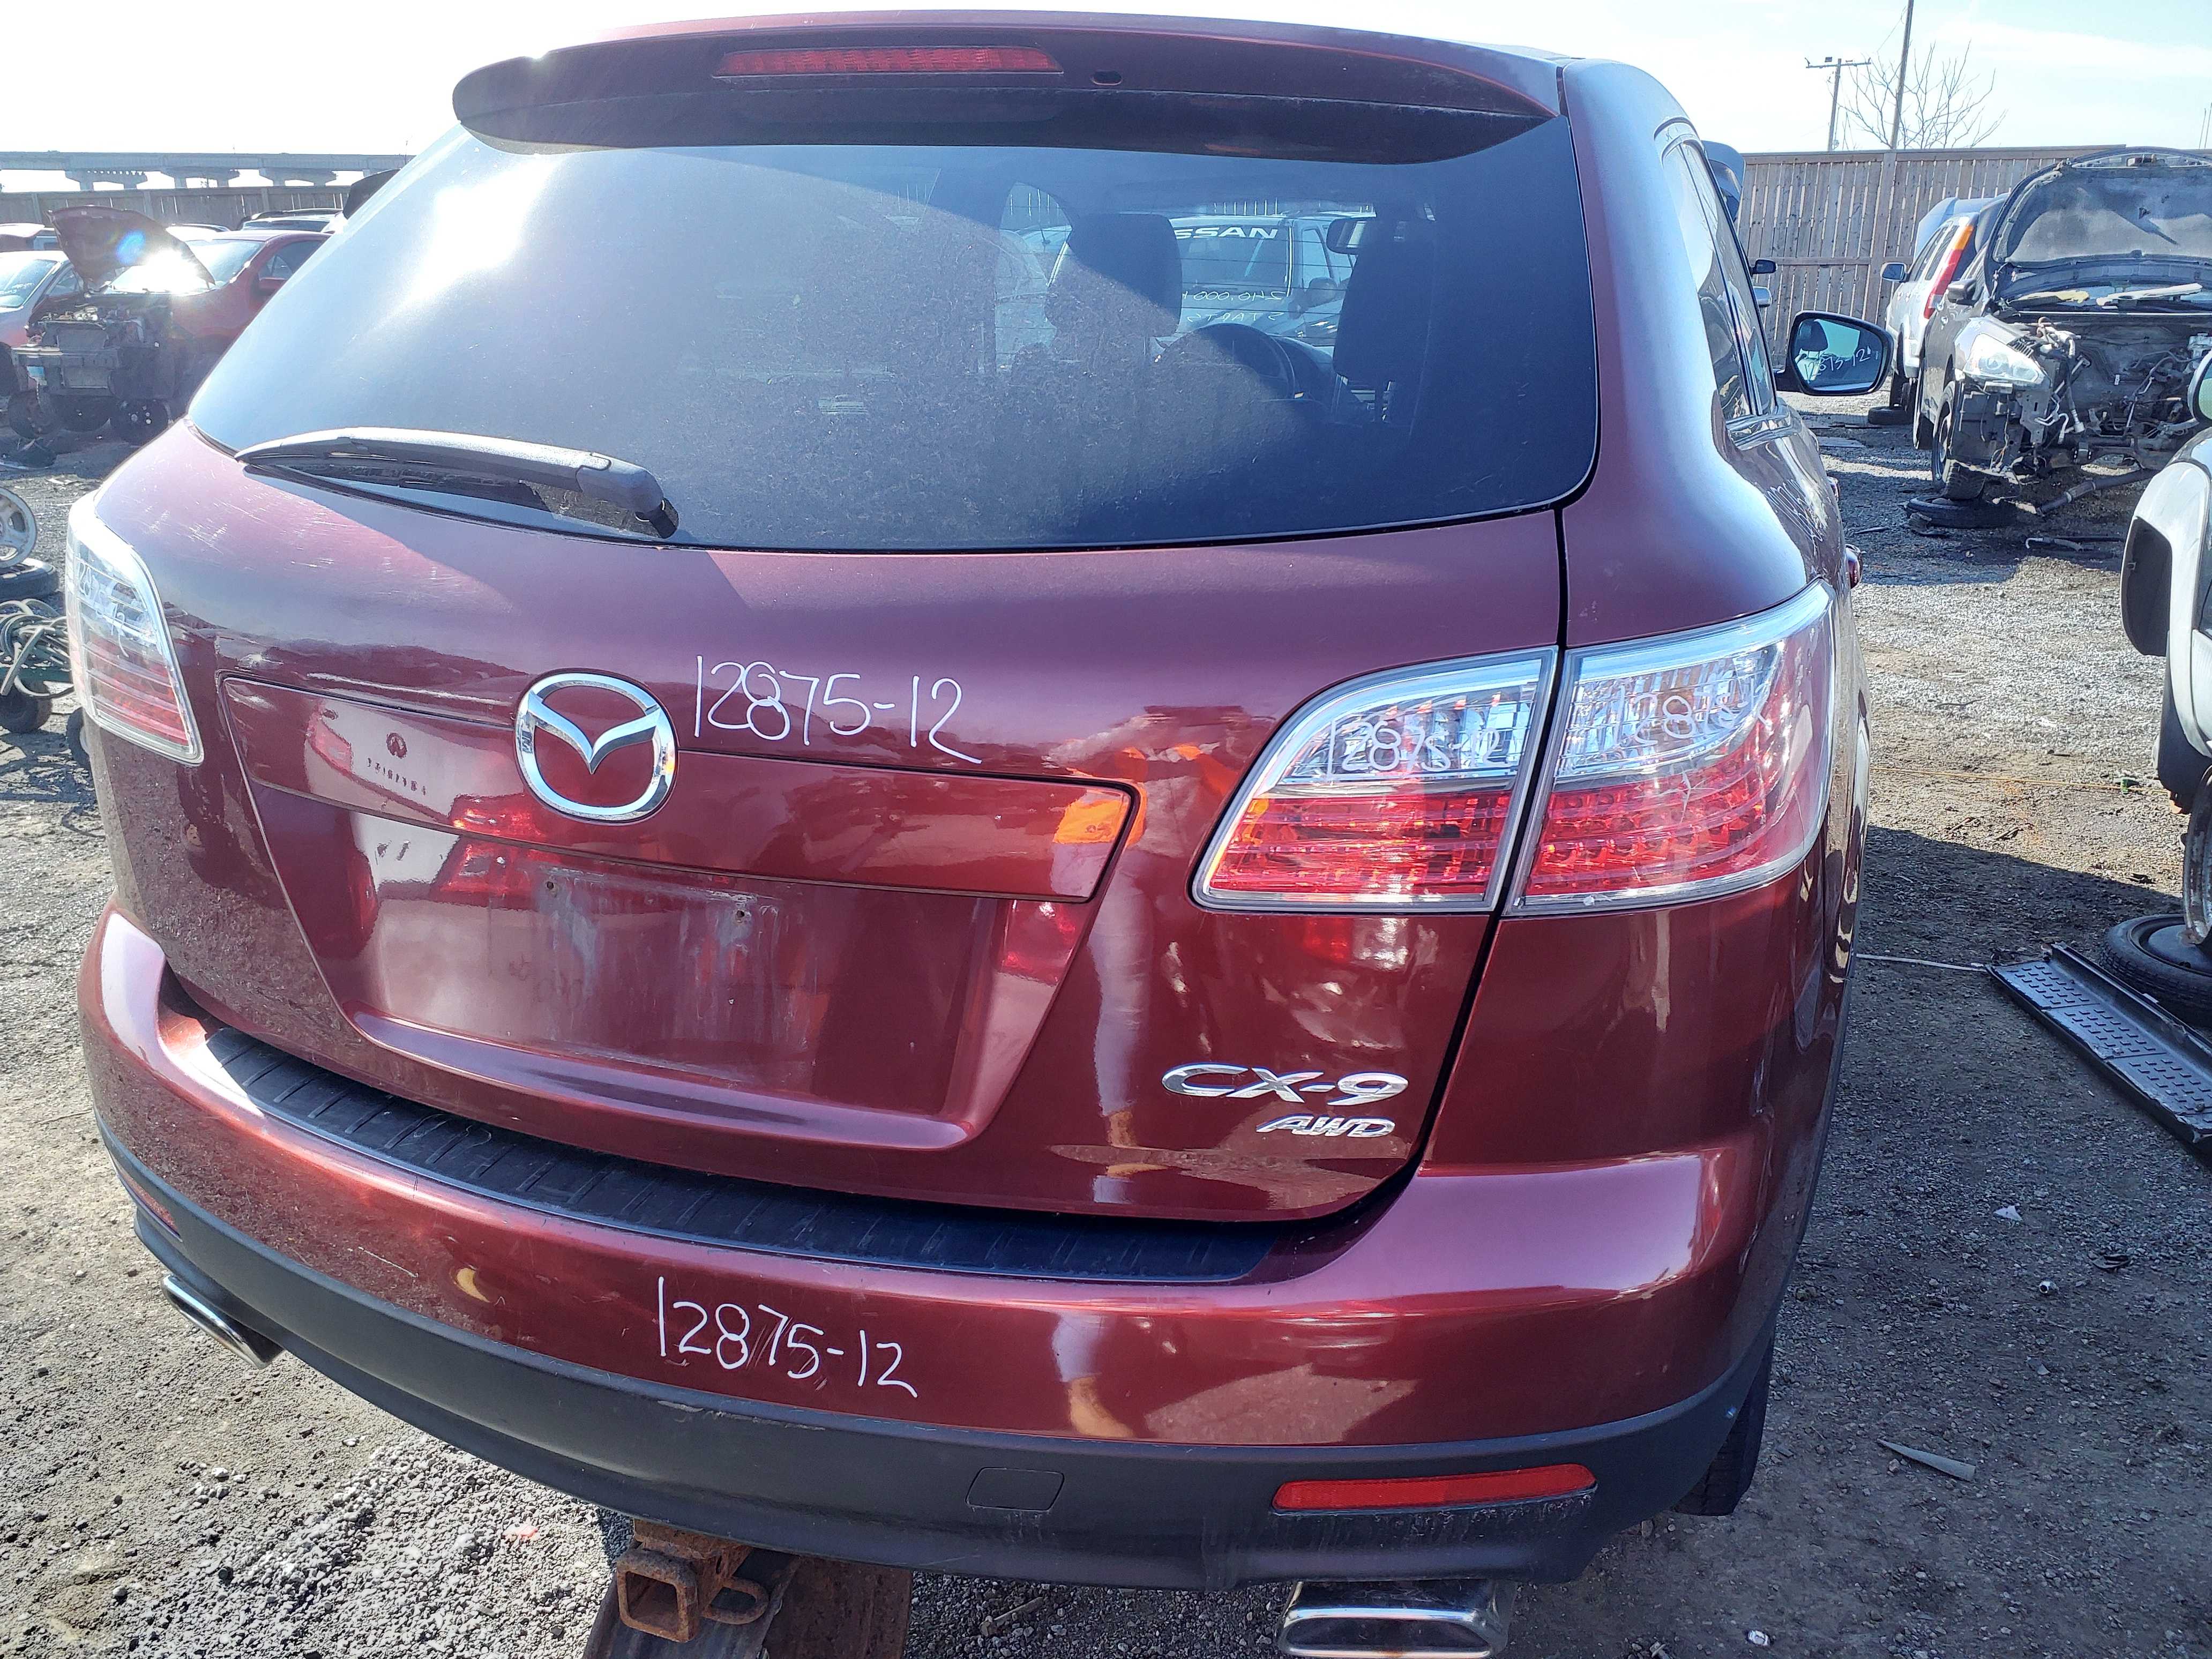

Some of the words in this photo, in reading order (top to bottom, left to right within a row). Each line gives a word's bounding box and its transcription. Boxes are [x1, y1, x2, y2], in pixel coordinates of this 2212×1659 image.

[694, 655, 982, 764] 12875-12
[1327, 720, 1519, 782] 12875-12
[1162, 1063, 1409, 1106] CX-9
[1256, 1114, 1395, 1138] AWD
[659, 1276, 918, 1398] 12875-12
